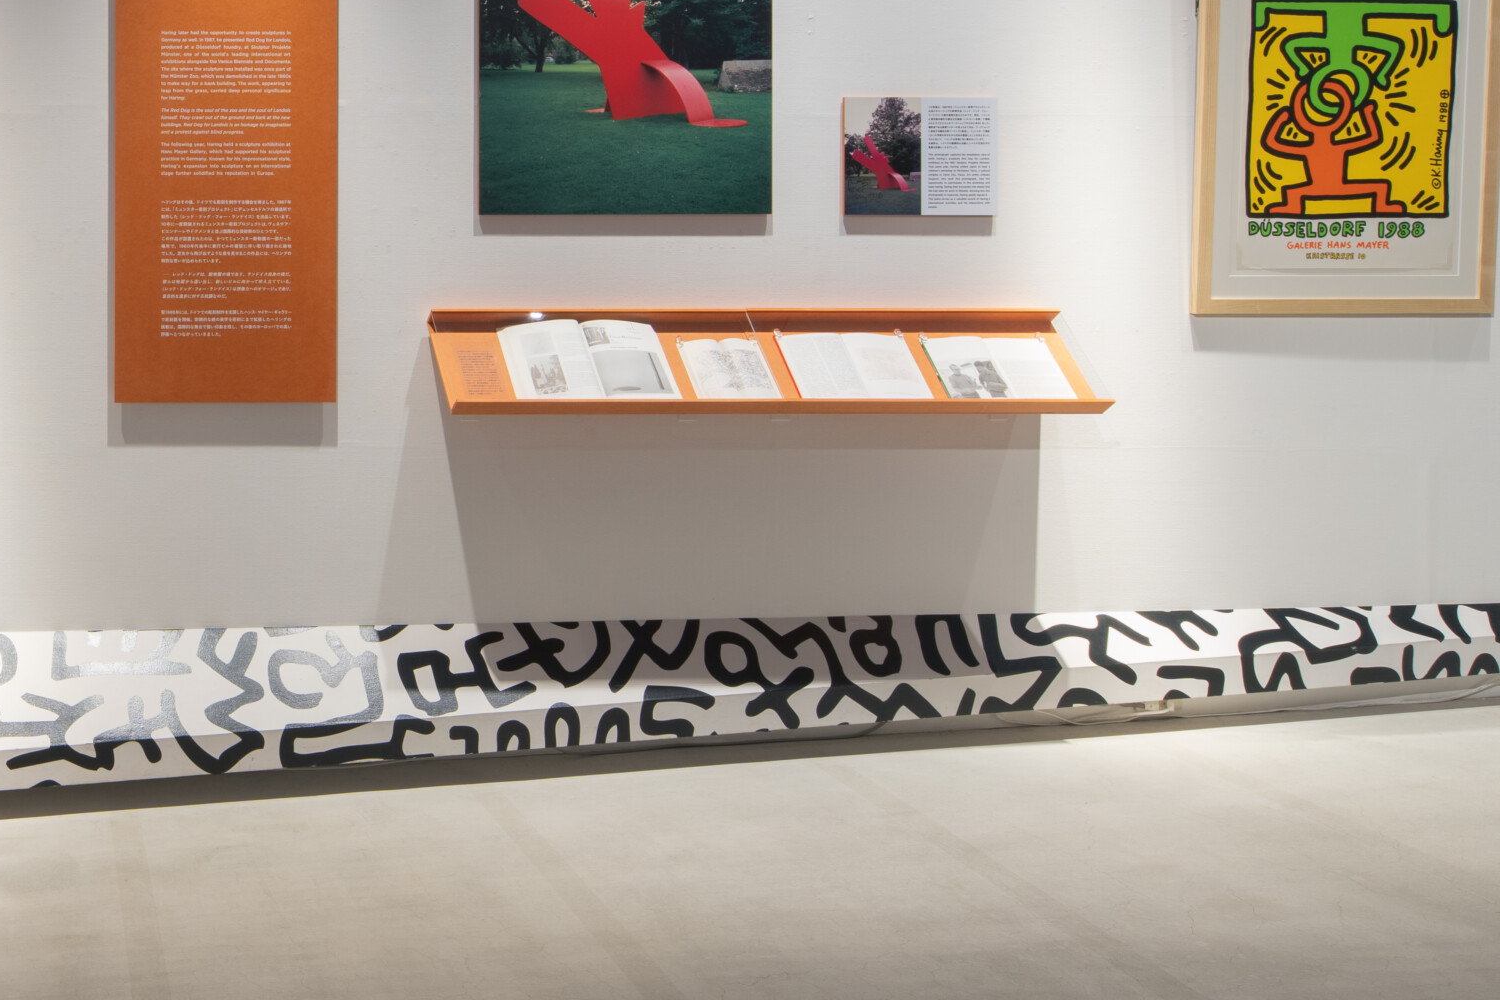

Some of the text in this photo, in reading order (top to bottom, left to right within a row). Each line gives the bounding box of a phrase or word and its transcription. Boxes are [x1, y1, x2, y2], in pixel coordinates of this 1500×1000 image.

[1439, 102, 1448, 122] 1988
[1248, 219, 1425, 238] DÜSSELDORF 1988
[1356, 241, 1389, 249] MAYER
